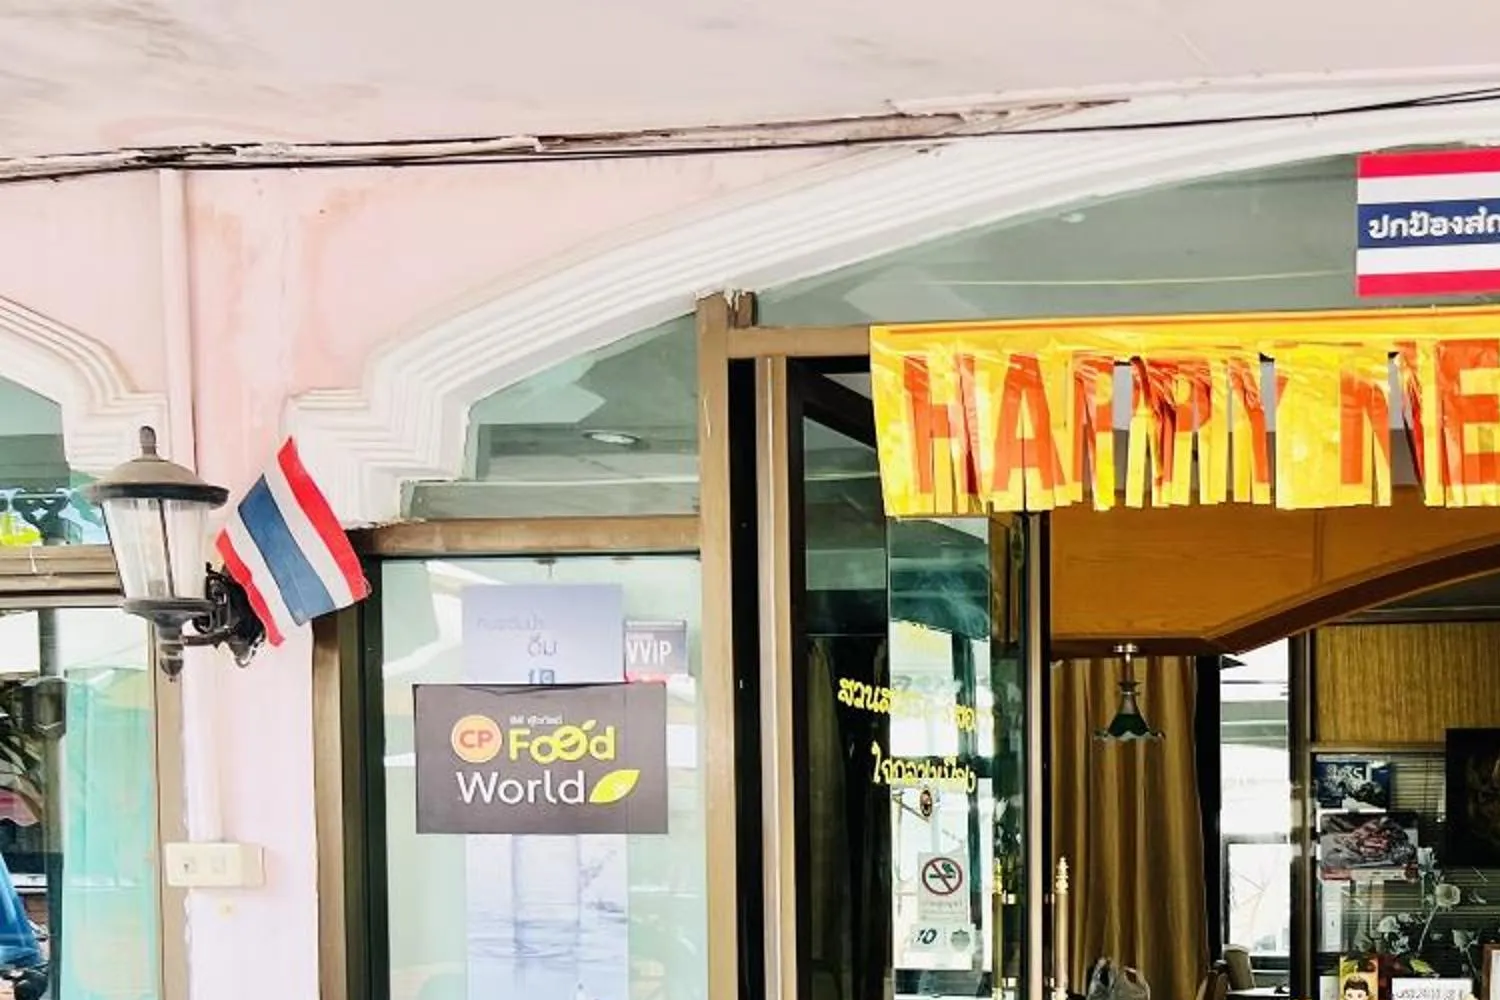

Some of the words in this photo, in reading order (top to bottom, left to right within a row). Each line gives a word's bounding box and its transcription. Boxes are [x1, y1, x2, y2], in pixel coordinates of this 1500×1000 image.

[626, 639, 672, 665] VVIP
[459, 730, 494, 749] CP
[509, 724, 616, 764] Food
[456, 769, 585, 805] World
